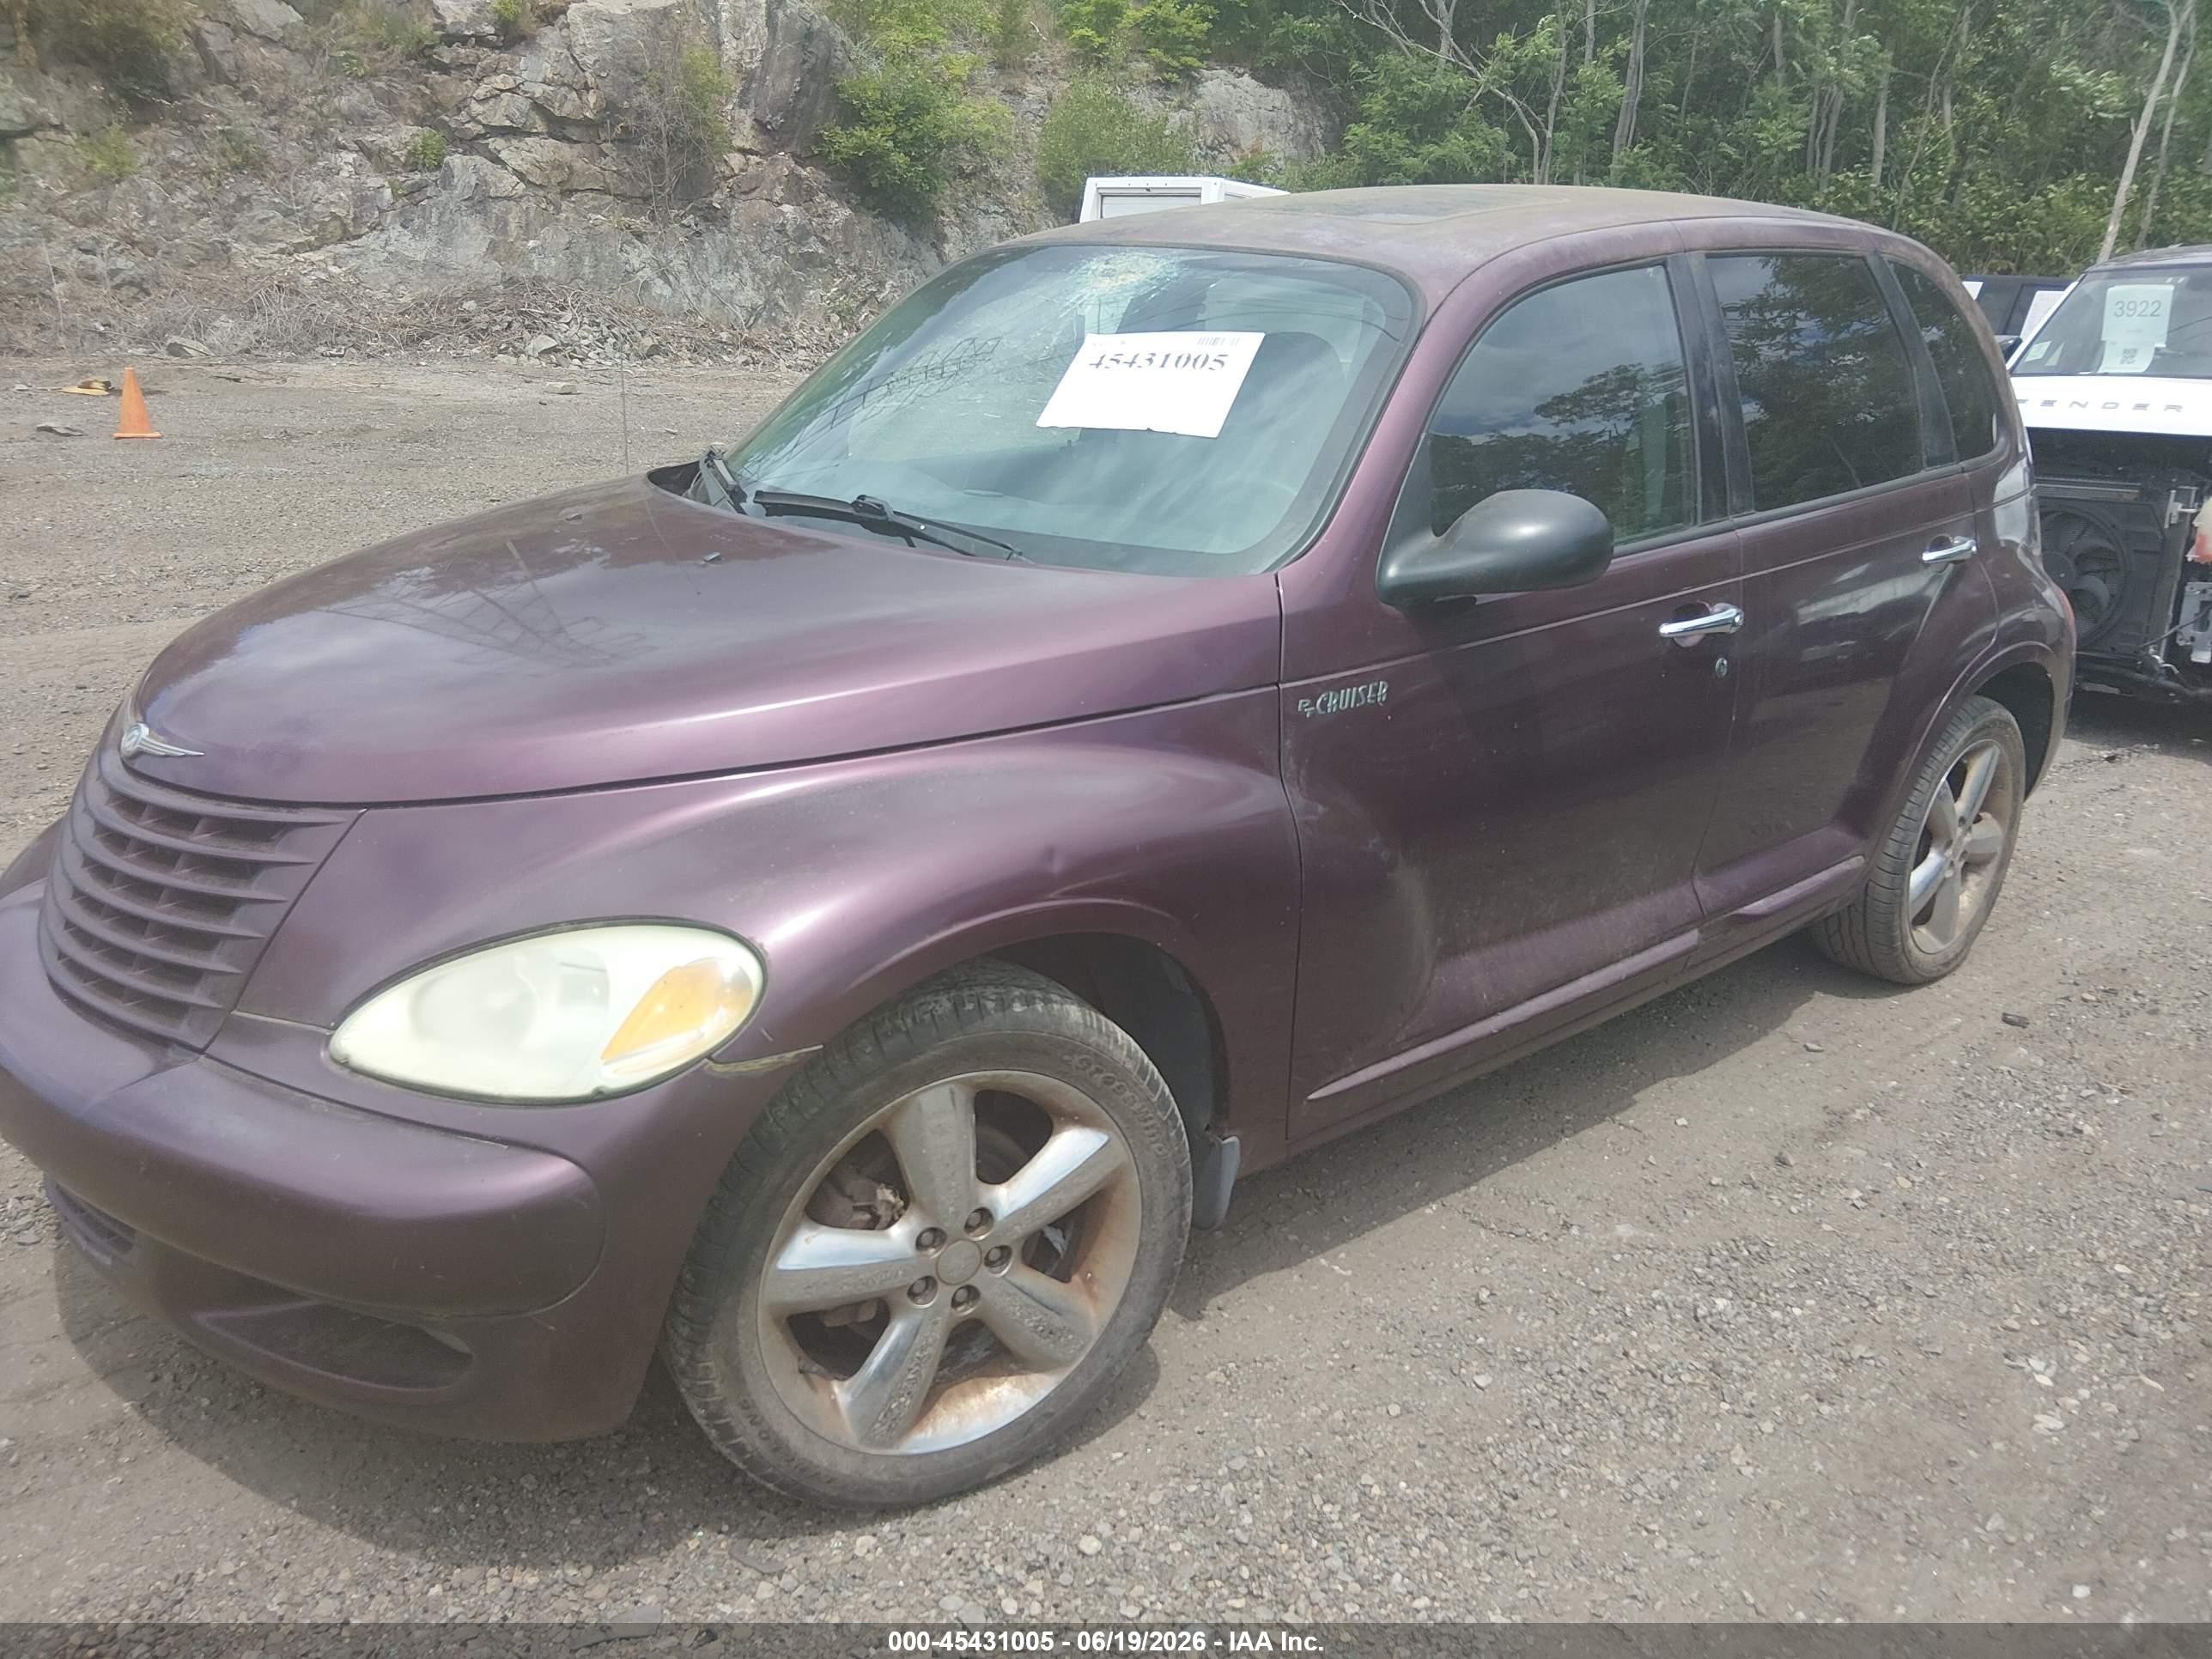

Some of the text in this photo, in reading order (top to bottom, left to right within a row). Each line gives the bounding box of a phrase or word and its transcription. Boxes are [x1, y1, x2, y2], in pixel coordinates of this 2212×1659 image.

[2113, 300, 2162, 318] 3922
[1088, 352, 1229, 371] 45431005
[1297, 680, 1389, 719] PT CRUISER
